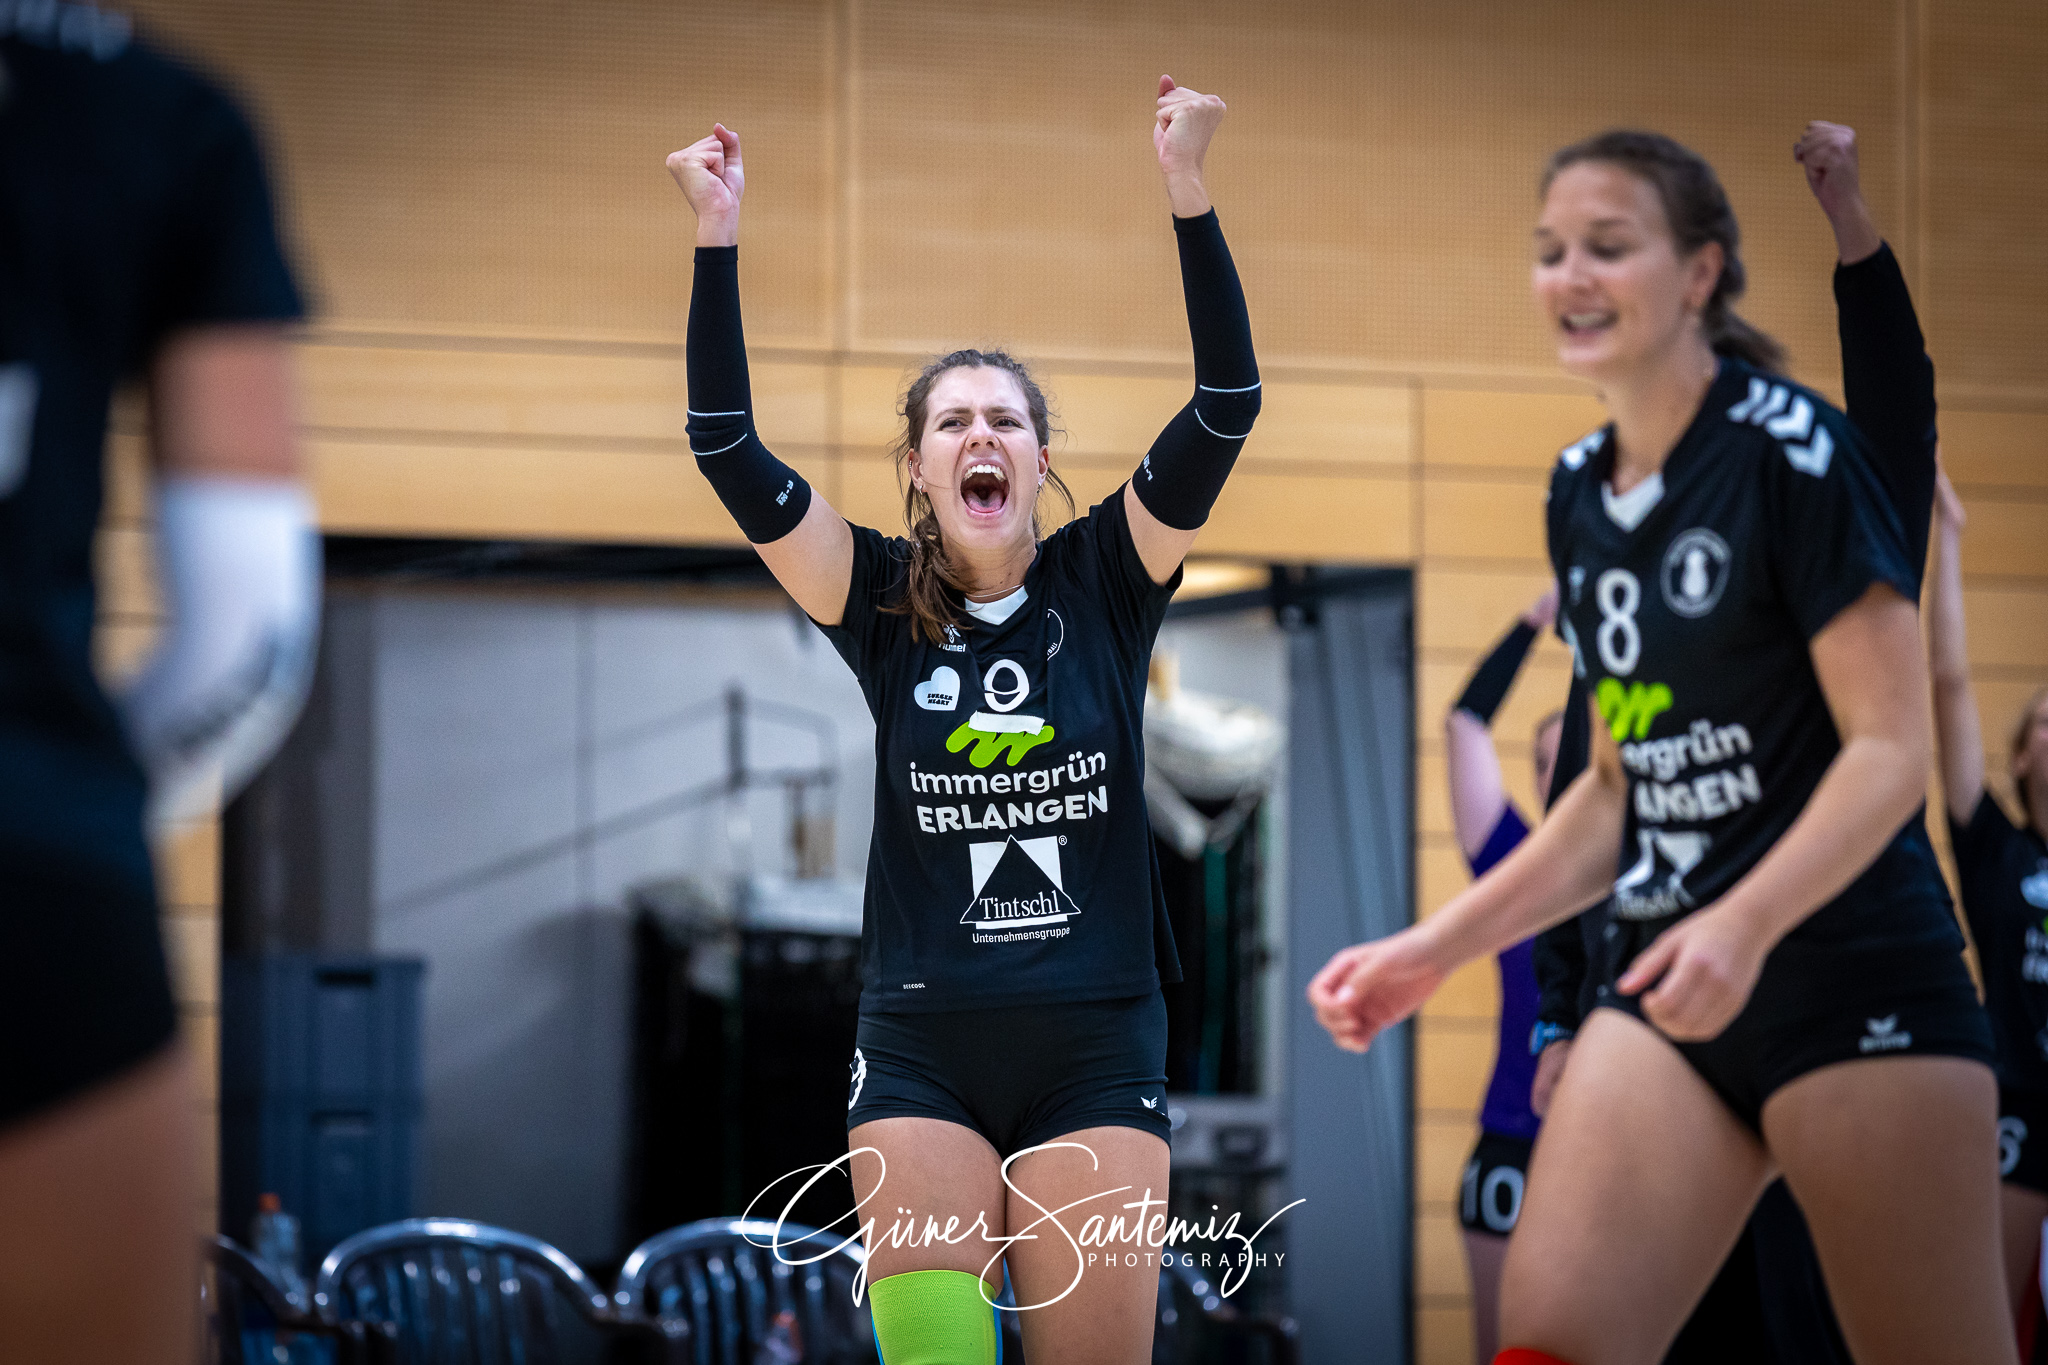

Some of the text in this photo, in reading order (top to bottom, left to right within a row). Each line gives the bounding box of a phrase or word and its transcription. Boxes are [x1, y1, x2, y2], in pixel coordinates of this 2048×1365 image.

[1596, 567, 1642, 677] 8
[909, 750, 1107, 795] immergrün
[916, 785, 1108, 834] ERLANGEN
[979, 889, 1061, 920] Tintschl
[972, 926, 1071, 944] Unternehmensgruppe
[1462, 1159, 1525, 1233] 10
